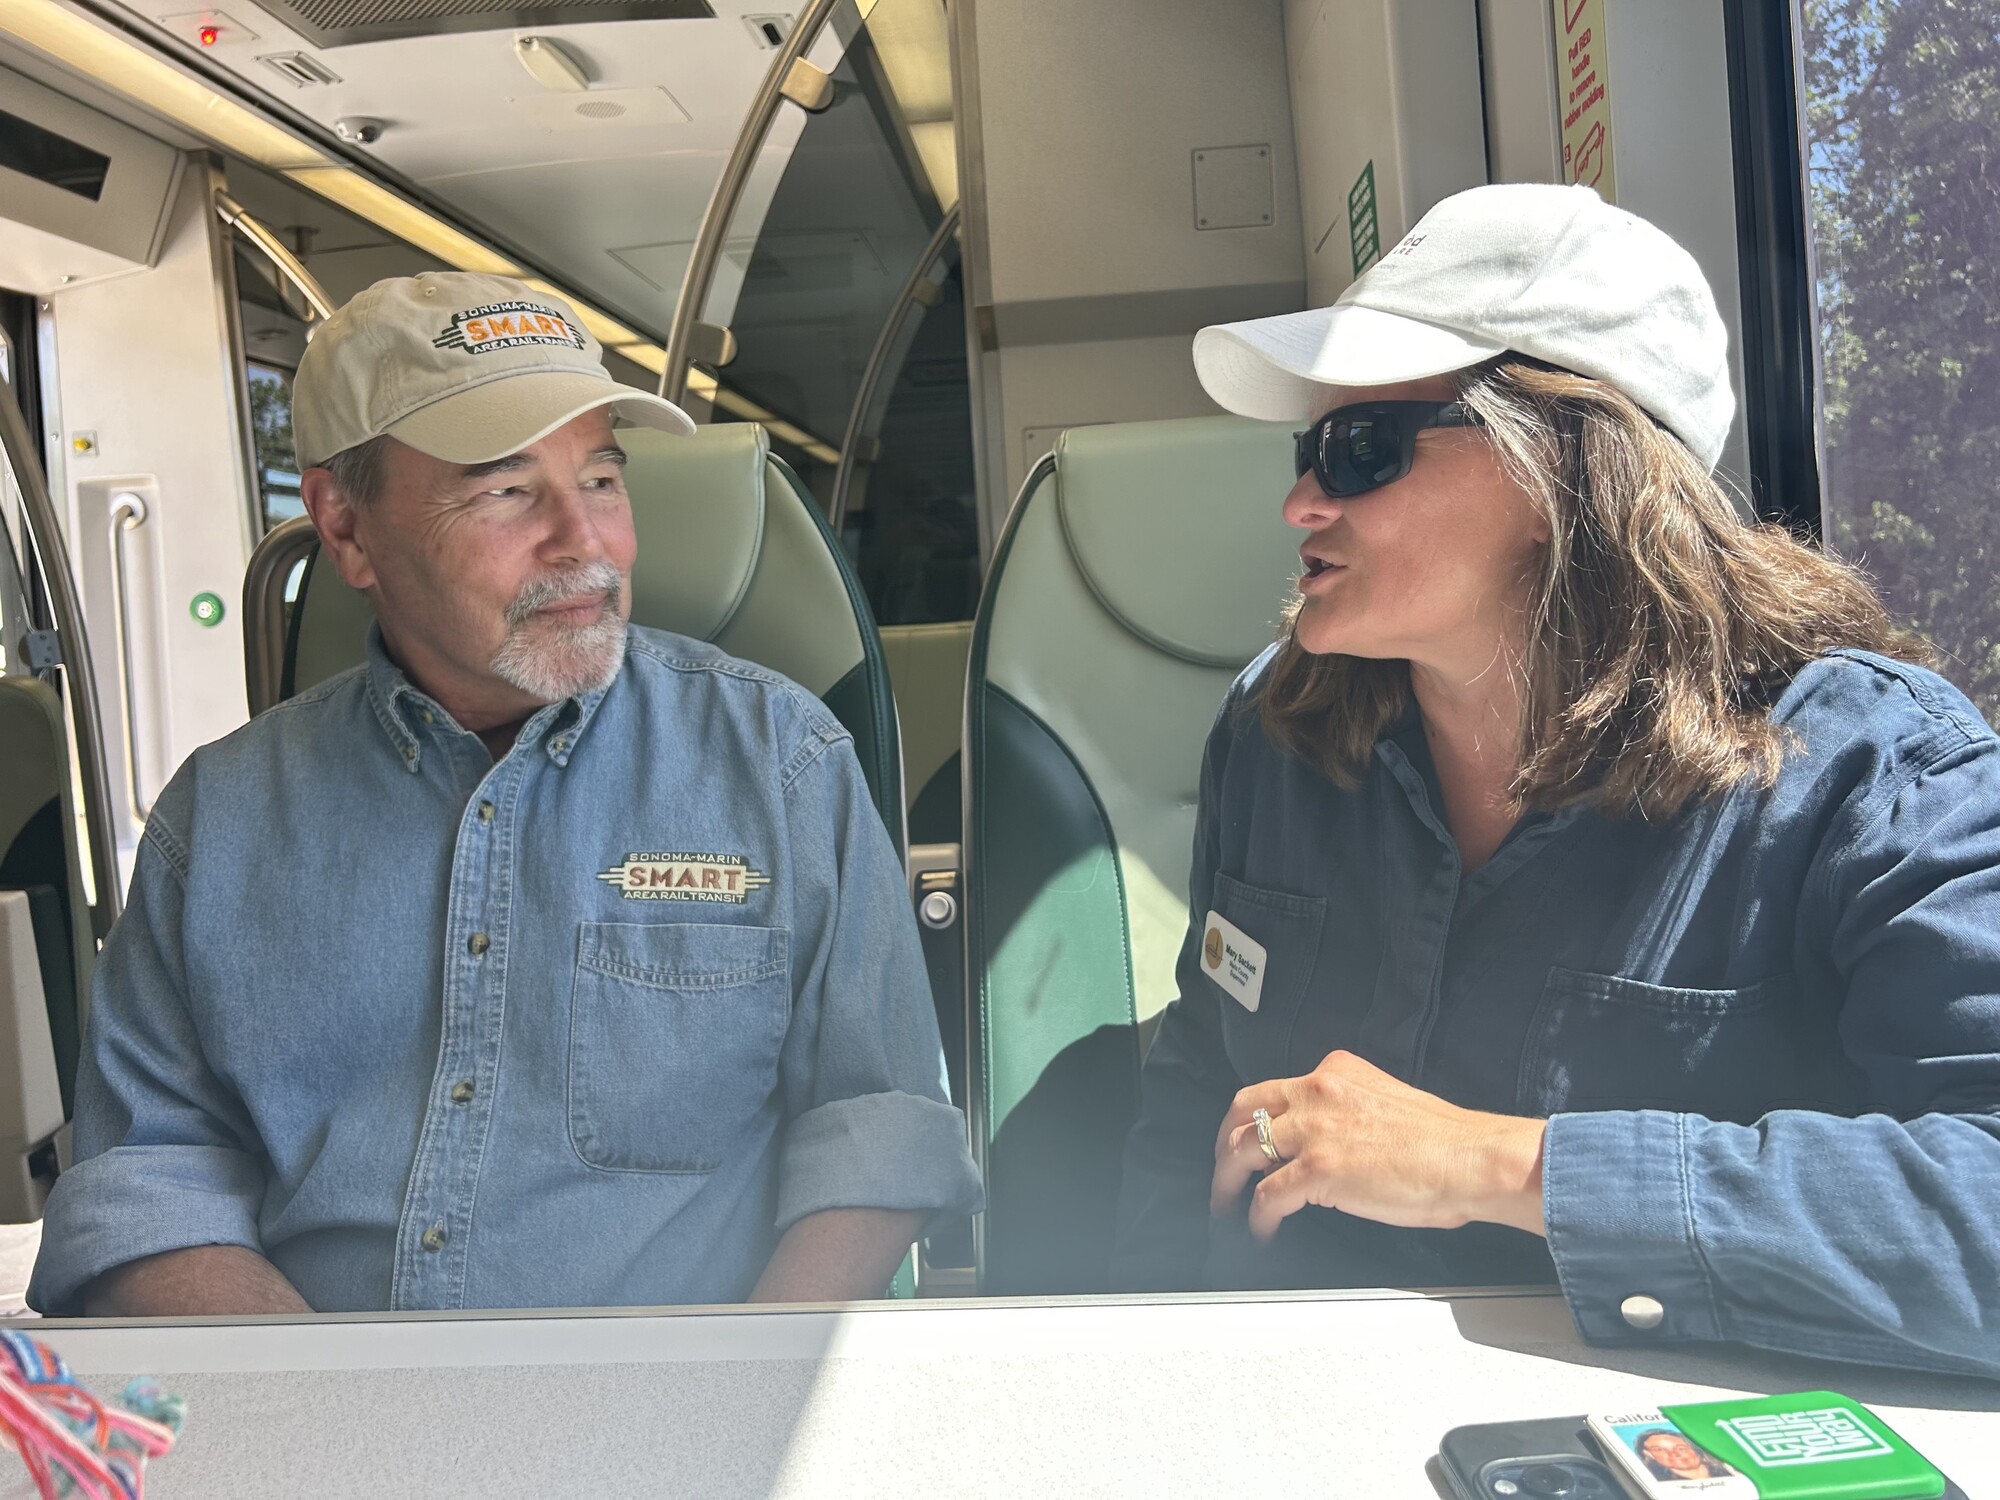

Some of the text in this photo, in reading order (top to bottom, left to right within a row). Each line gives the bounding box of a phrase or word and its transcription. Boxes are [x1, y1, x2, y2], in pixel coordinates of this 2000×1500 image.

[1568, 27, 1592, 63] Pull RED
[1571, 53, 1590, 81] handle
[1569, 70, 1596, 105] to remove
[1564, 83, 1605, 130] rubber molding
[466, 314, 569, 341] SMART
[473, 340, 510, 354] AREA
[510, 338, 536, 348] RAIL
[629, 852, 741, 865] SONOMA-MARIN
[628, 866, 742, 891] SMART
[624, 891, 745, 904] AREA RAIL TRANSIT
[1226, 944, 1238, 961] Mary
[1603, 1411, 1660, 1424] Califor
